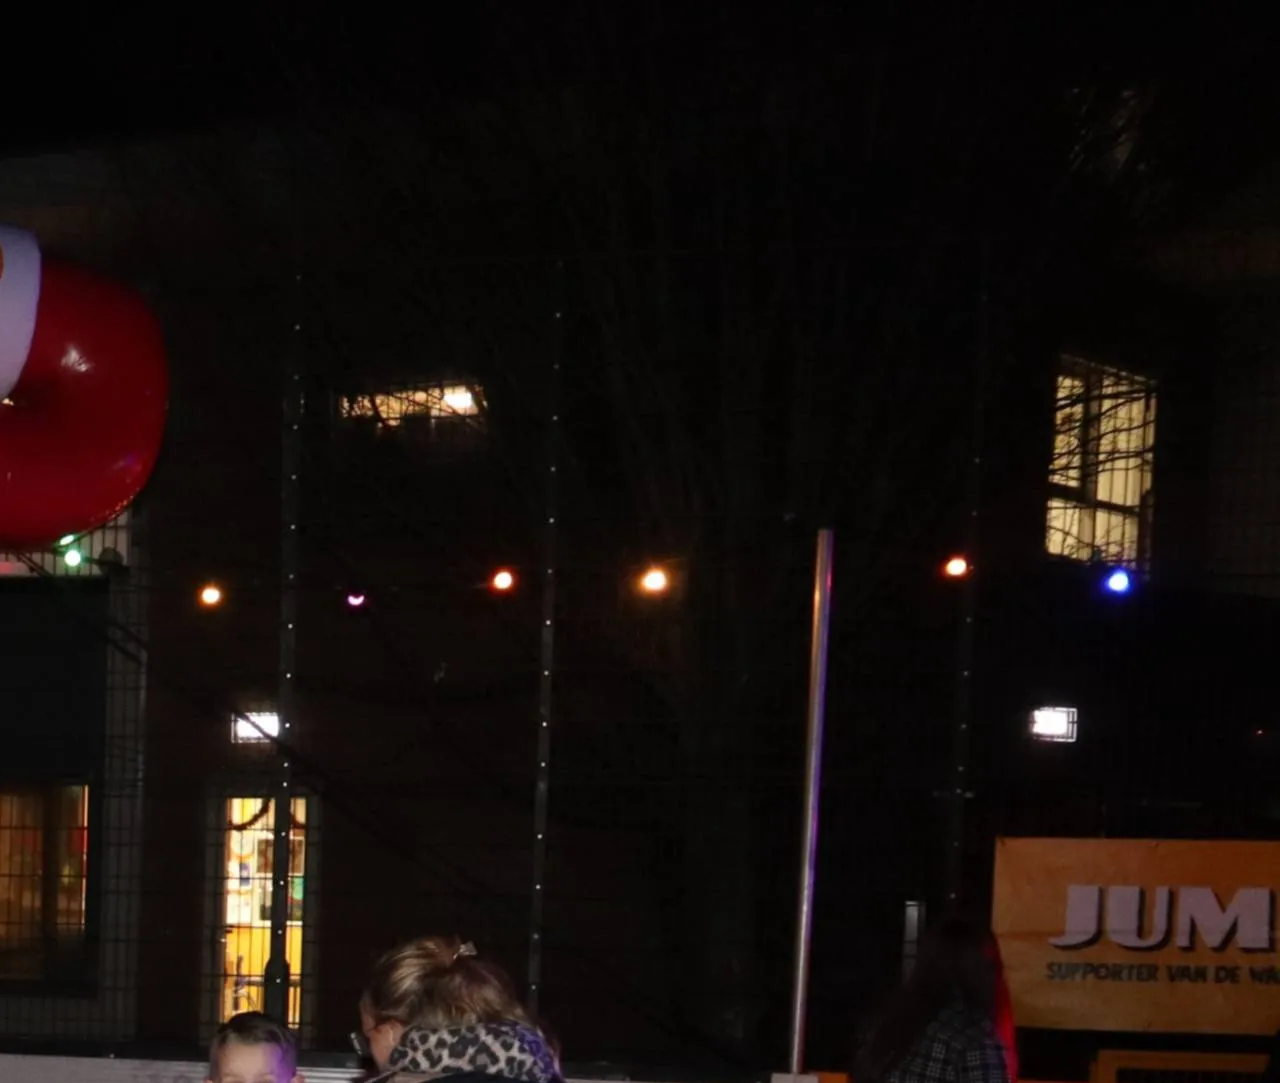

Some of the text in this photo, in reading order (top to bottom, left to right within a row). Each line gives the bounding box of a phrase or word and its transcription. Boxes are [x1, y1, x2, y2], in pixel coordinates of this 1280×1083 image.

[1047, 961, 1159, 982] SUPPORTER
[1166, 964, 1207, 983] VAN
[1215, 966, 1241, 983] DE
